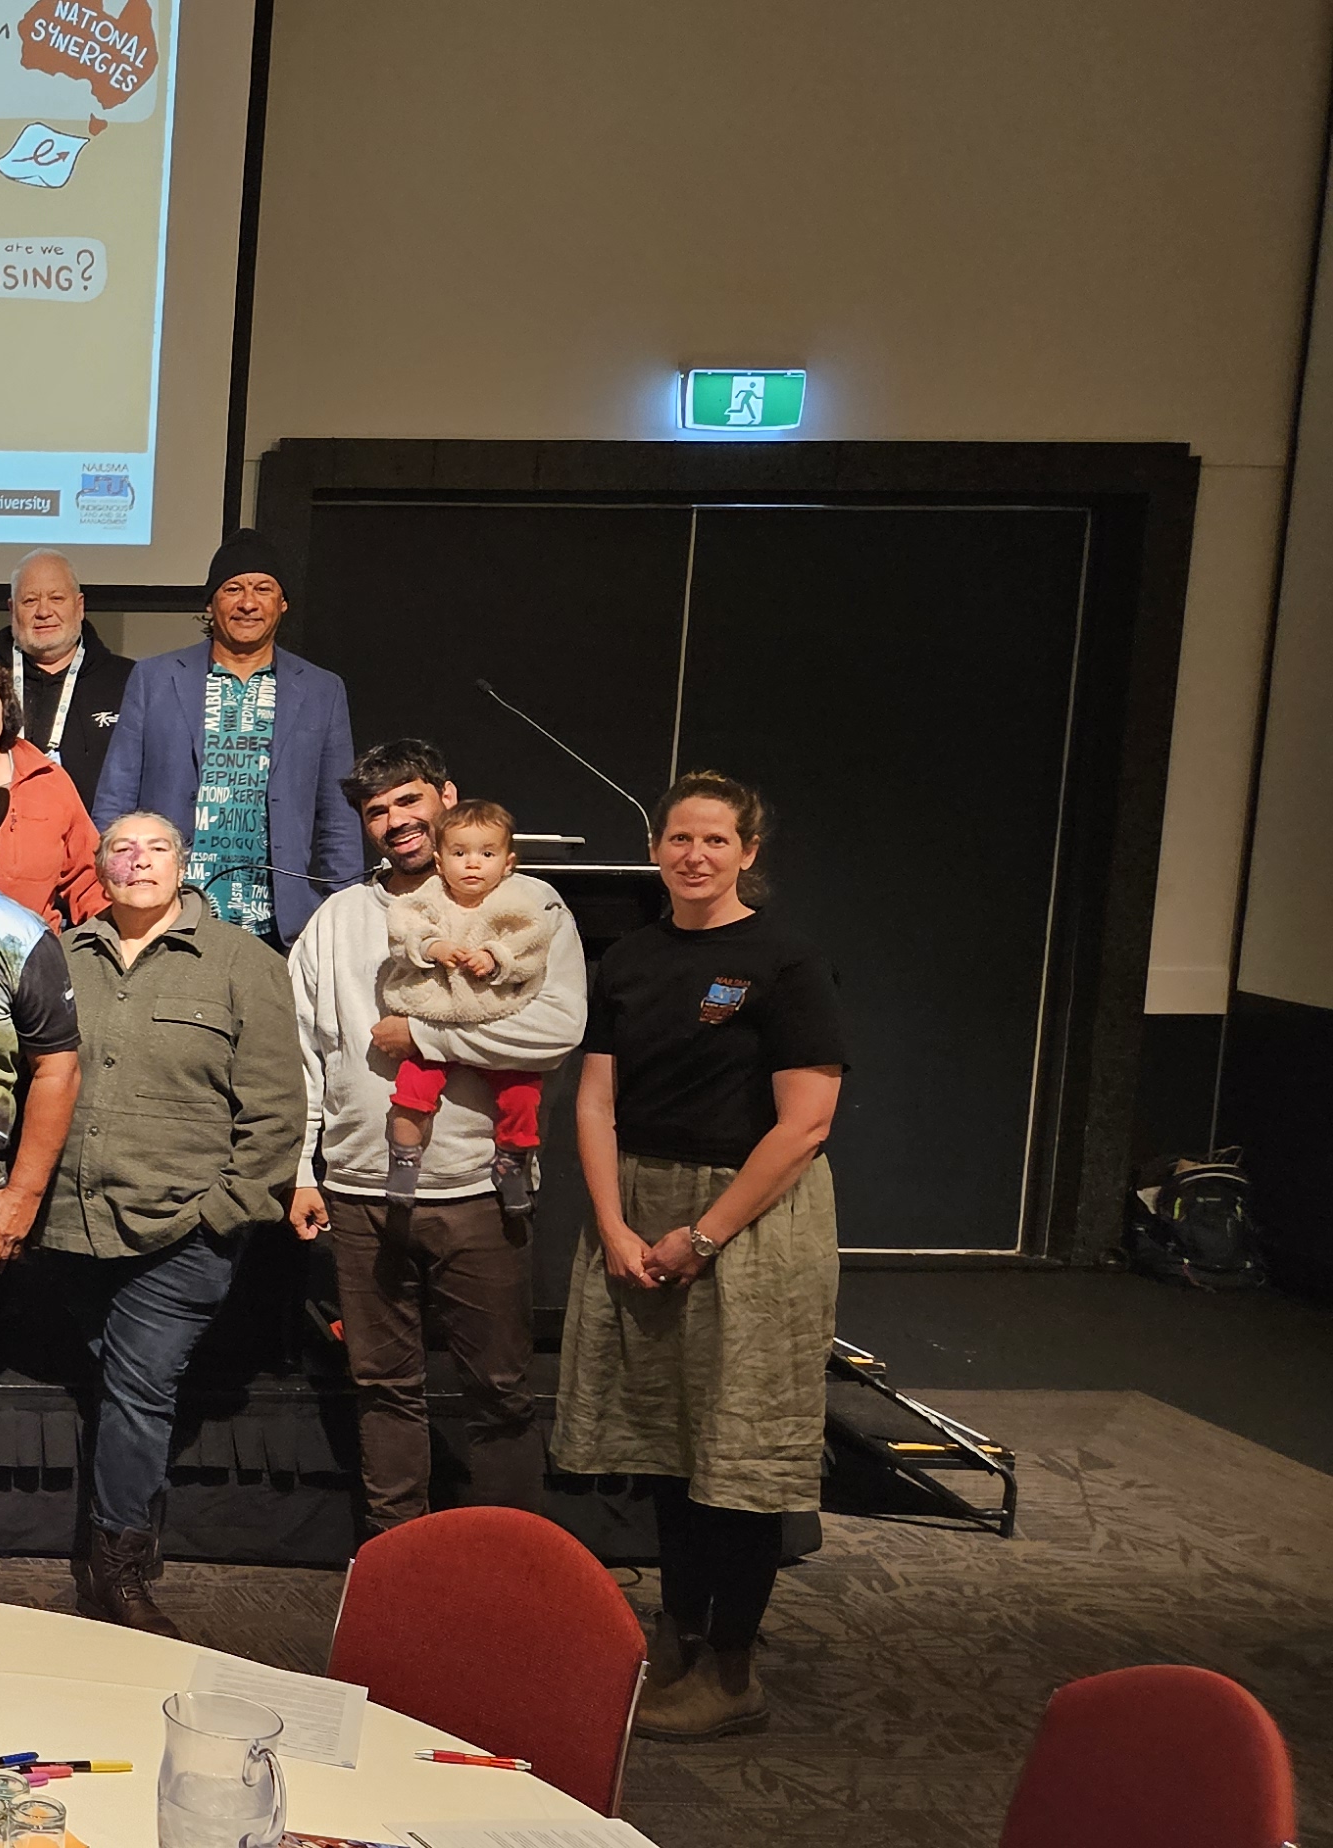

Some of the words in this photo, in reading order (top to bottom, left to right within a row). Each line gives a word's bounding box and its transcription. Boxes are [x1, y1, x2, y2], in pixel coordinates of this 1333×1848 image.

[31, 19, 138, 92] SYNERGIES
[54, 0, 148, 69] NATIONAL
[5, 243, 33, 254] are
